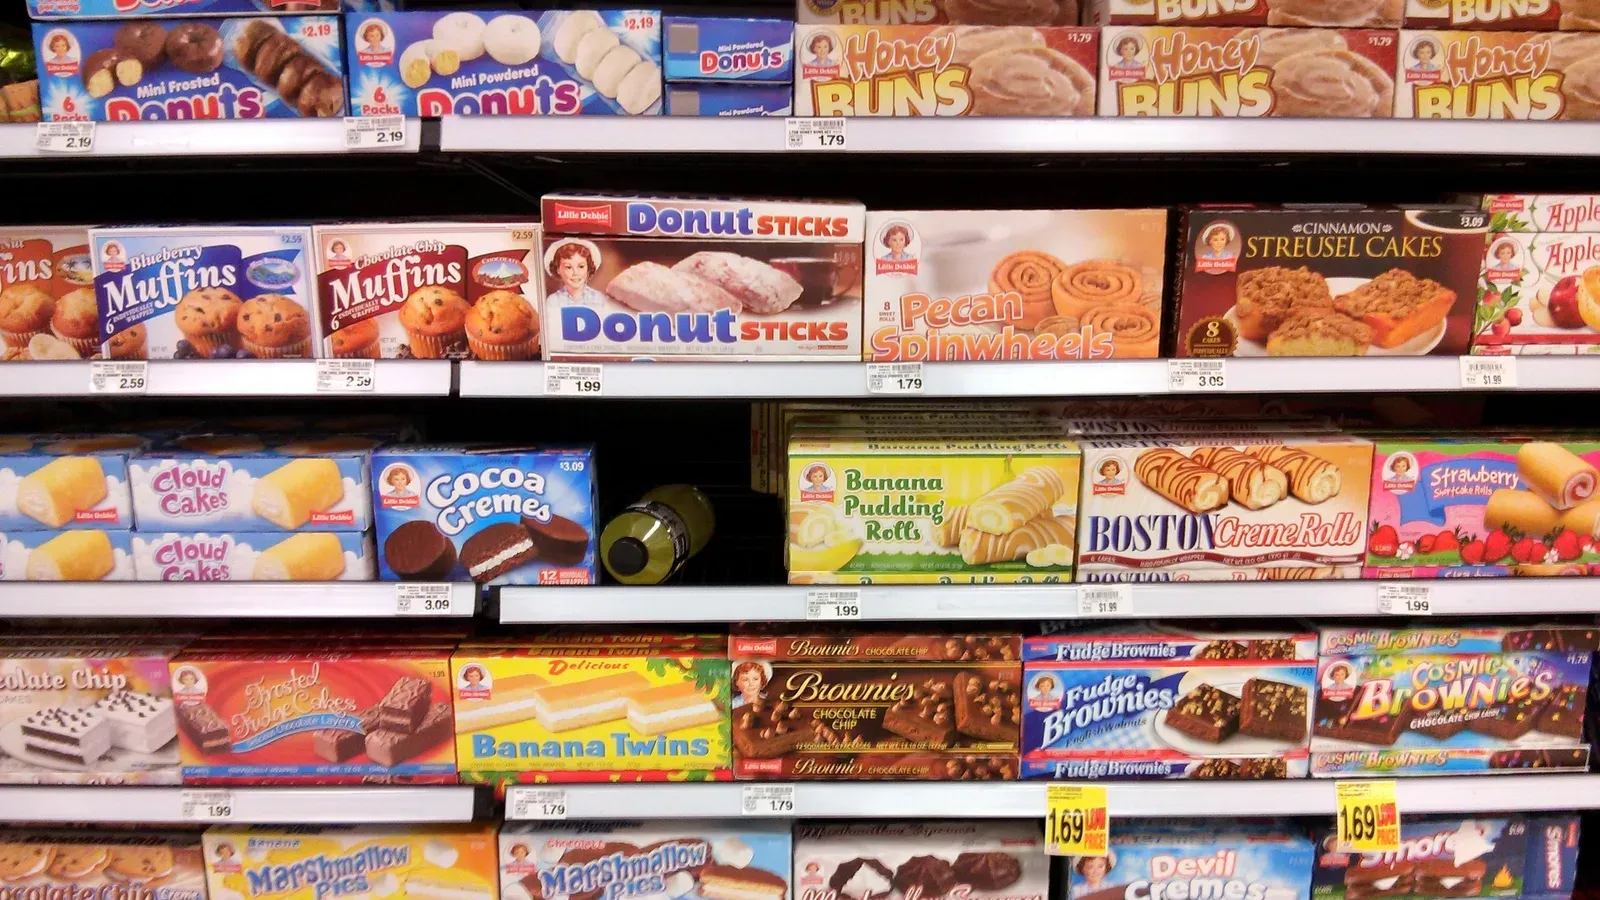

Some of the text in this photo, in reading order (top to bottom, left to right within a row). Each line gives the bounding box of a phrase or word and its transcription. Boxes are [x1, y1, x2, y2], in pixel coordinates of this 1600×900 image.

[302, 24, 332, 39] $2.19
[624, 16, 654, 31] $2.19
[1067, 33, 1092, 44] $1.79
[700, 47, 784, 74] Donuts
[844, 29, 956, 83] Honey
[1149, 31, 1260, 85] Honey
[1445, 35, 1551, 88] Honey
[137, 74, 220, 99] Mini Frosted
[451, 64, 540, 90] Mini Powdered
[105, 83, 266, 121] Donuts
[373, 87, 386, 104] 6
[417, 76, 582, 117] Donuts
[812, 66, 974, 117] BUNS
[1117, 66, 1276, 118] BUNS
[1413, 69, 1566, 121] BUNS
[62, 97, 75, 113] 6
[362, 104, 400, 116] Packs
[66, 137, 92, 149] 2.19
[376, 131, 403, 143] 2.19
[818, 134, 845, 146] 1.79
[557, 210, 609, 221] Little Debbie
[626, 202, 849, 242] Donut STICKS
[1461, 216, 1484, 228] $3.09
[512, 230, 534, 244] $2.59
[1302, 222, 1382, 235] CINNAMON
[129, 243, 204, 276] Blueberry
[353, 239, 446, 271] Chocolate Chip
[1245, 235, 1443, 260] STREUSEL CAKES
[877, 263, 916, 271] Little Debbie
[103, 256, 237, 317] Muffins
[328, 256, 462, 315] Muffins
[330, 314, 340, 331] 6
[899, 292, 1023, 331] Pecan
[105, 318, 115, 335] 6
[560, 305, 849, 344] Donut STICKS
[1206, 321, 1220, 338] 8
[870, 325, 1114, 361] Spinwheels
[119, 378, 145, 389] 2.59
[346, 375, 372, 387] 2.59
[575, 380, 601, 392] 1.99
[897, 378, 922, 390] 1.79
[1483, 375, 1502, 385] $1.99
[153, 466, 227, 492] Cloud
[560, 461, 585, 476] $3.09
[844, 468, 944, 492] Banana
[1430, 465, 1519, 490] Strawberry
[427, 467, 546, 508] Cocoa
[161, 487, 229, 517] Cakes
[844, 494, 946, 527] Pudding
[312, 513, 353, 522] Little Debbie
[437, 493, 552, 536] Cremes
[865, 520, 922, 543] Rolls
[1087, 512, 1362, 552] BOSTON Creme Rolls
[155, 540, 229, 566] Cloud
[424, 600, 450, 611] 3.09
[834, 605, 859, 617] 1.99
[1098, 602, 1118, 613] $1.99
[1405, 600, 1429, 611] 1.99
[787, 638, 860, 660] Brownies
[1055, 643, 1110, 663] Fudge
[1110, 643, 1178, 658] Brownies
[548, 660, 629, 676] Delicious
[71, 667, 127, 697] Chip
[245, 661, 322, 709] Frosted
[779, 669, 916, 702] Brownies
[1065, 673, 1137, 711] Fudge
[812, 708, 877, 720] CHOCOLATE
[831, 719, 857, 730] CHIP
[1042, 685, 1180, 750] Brownies
[1410, 714, 1463, 729] CHOCOLATE
[472, 732, 710, 759] Banana Twins
[791, 758, 864, 776] Brownies
[1054, 760, 1172, 780] Fudge Brownies
[207, 806, 231, 817] 1.99
[541, 804, 565, 815] 1.79
[769, 800, 793, 811] 1.79
[1048, 807, 1106, 846] 1.69 LOW
[1340, 802, 1397, 843] 1.69 LOW
[245, 845, 410, 896] Marshmallow
[539, 841, 709, 898] Marshmallow
[1150, 848, 1237, 880] Devil
[314, 875, 370, 900] Pies
[607, 873, 667, 900] Pies
[1124, 878, 1269, 900] Cremes
